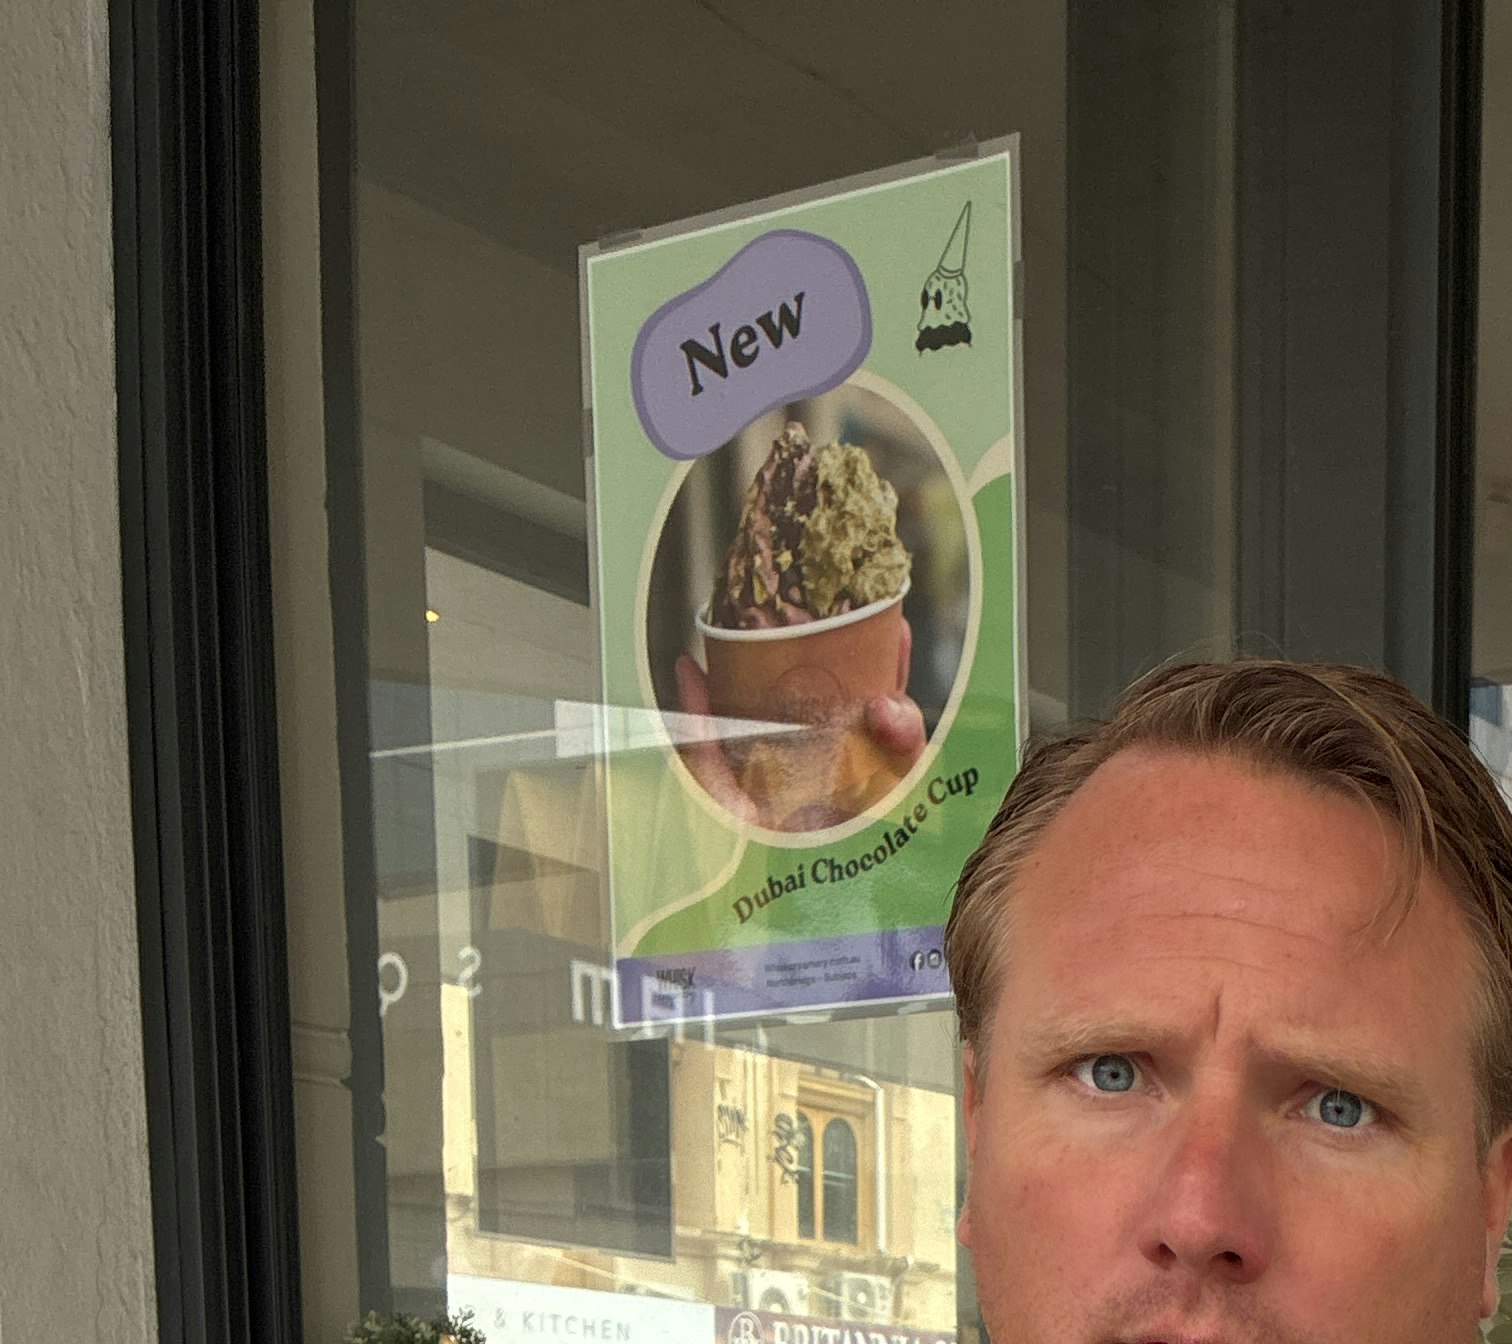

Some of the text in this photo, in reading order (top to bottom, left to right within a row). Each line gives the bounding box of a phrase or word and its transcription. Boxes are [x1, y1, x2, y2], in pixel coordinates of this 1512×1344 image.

[679, 291, 805, 396] New
[731, 767, 979, 924] Dubai Chocolate Cup
[494, 1307, 506, 1329] &
[522, 1310, 632, 1342] KITCHEN
